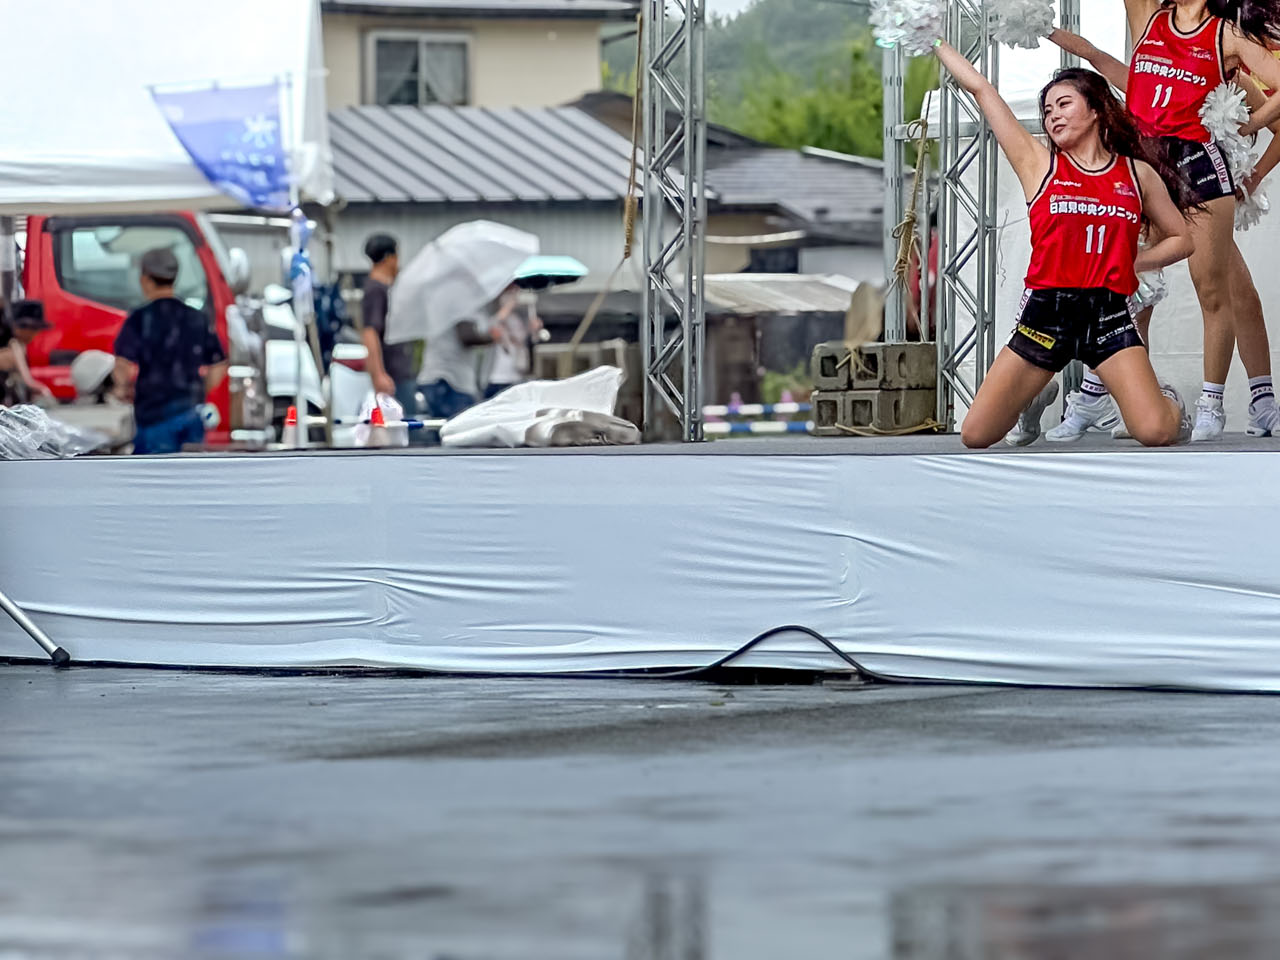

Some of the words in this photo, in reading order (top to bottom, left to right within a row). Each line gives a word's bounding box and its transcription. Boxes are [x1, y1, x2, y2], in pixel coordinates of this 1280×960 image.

[1134, 60, 1207, 86] 日高見中央クリニック
[1151, 83, 1173, 108] 11
[1049, 200, 1139, 224] 日高見中央クリニック
[1085, 223, 1106, 254] 11
